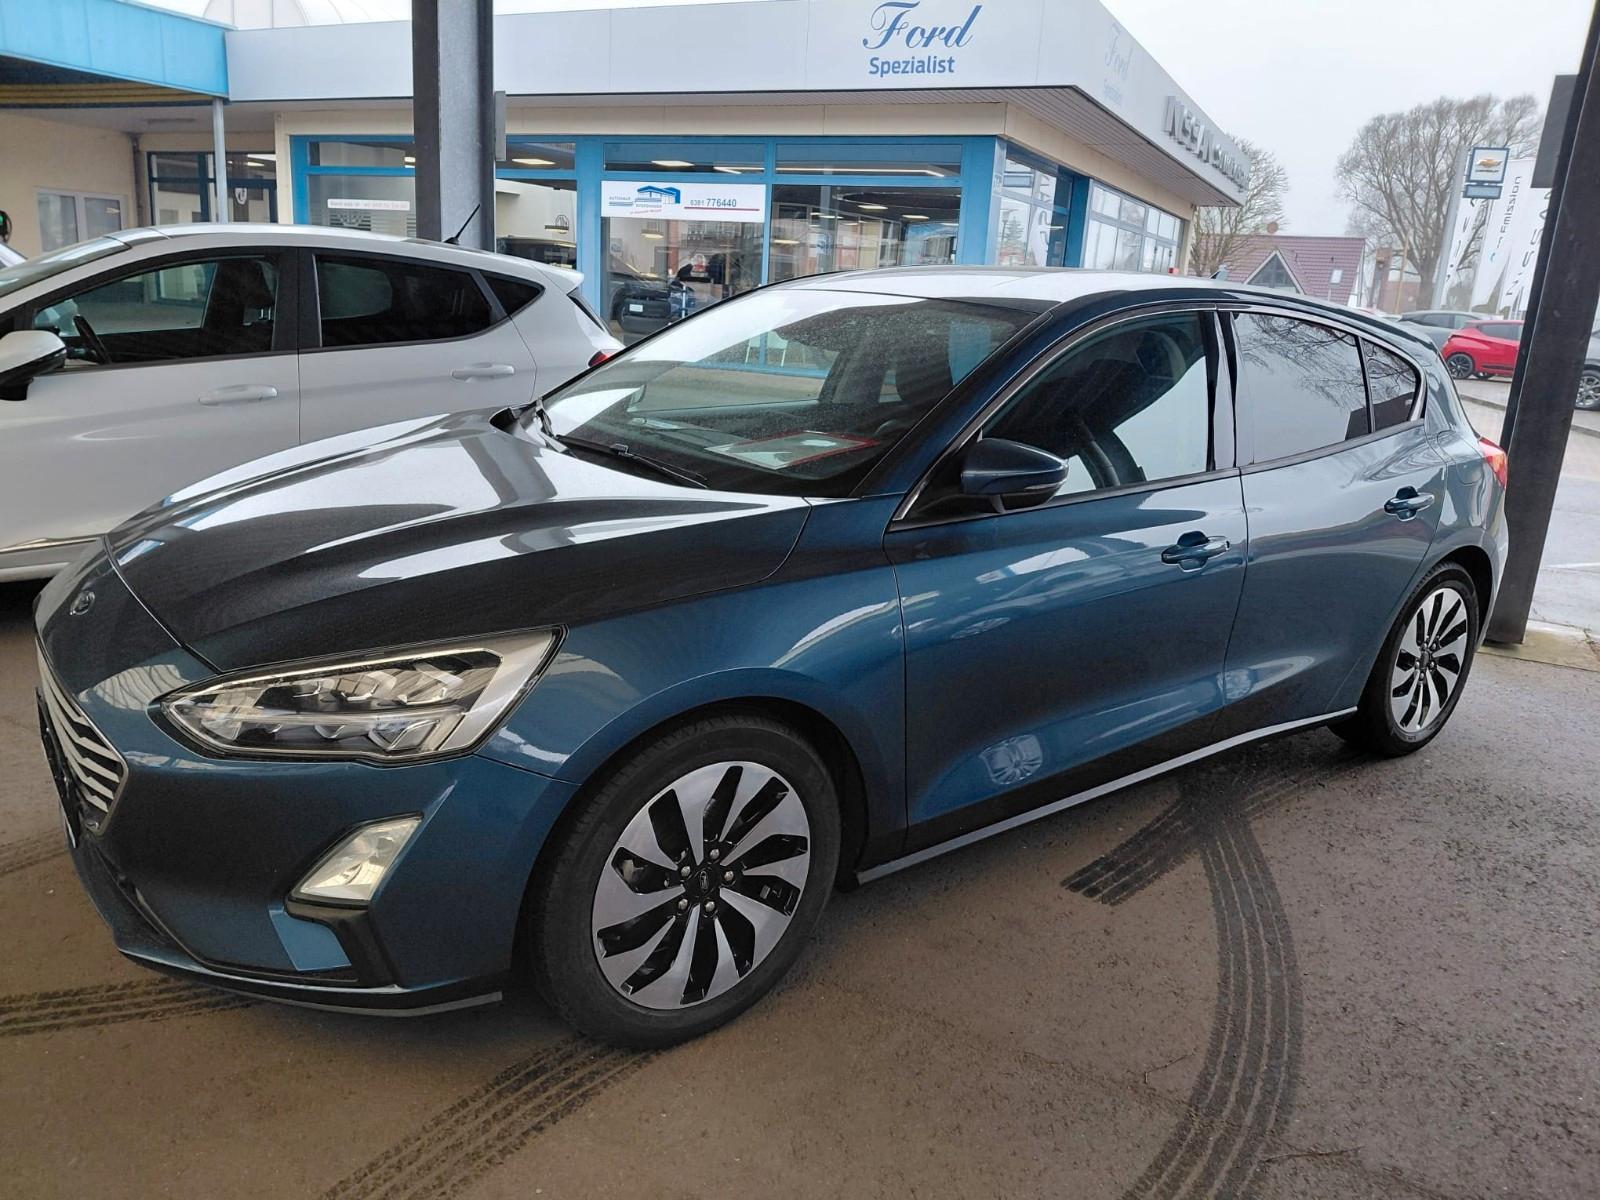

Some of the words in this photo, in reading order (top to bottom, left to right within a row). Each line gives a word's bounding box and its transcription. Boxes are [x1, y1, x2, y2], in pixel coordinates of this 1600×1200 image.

[862, 1, 983, 49] Ford
[869, 56, 955, 78] Spezialist
[706, 198, 737, 208] 776440
